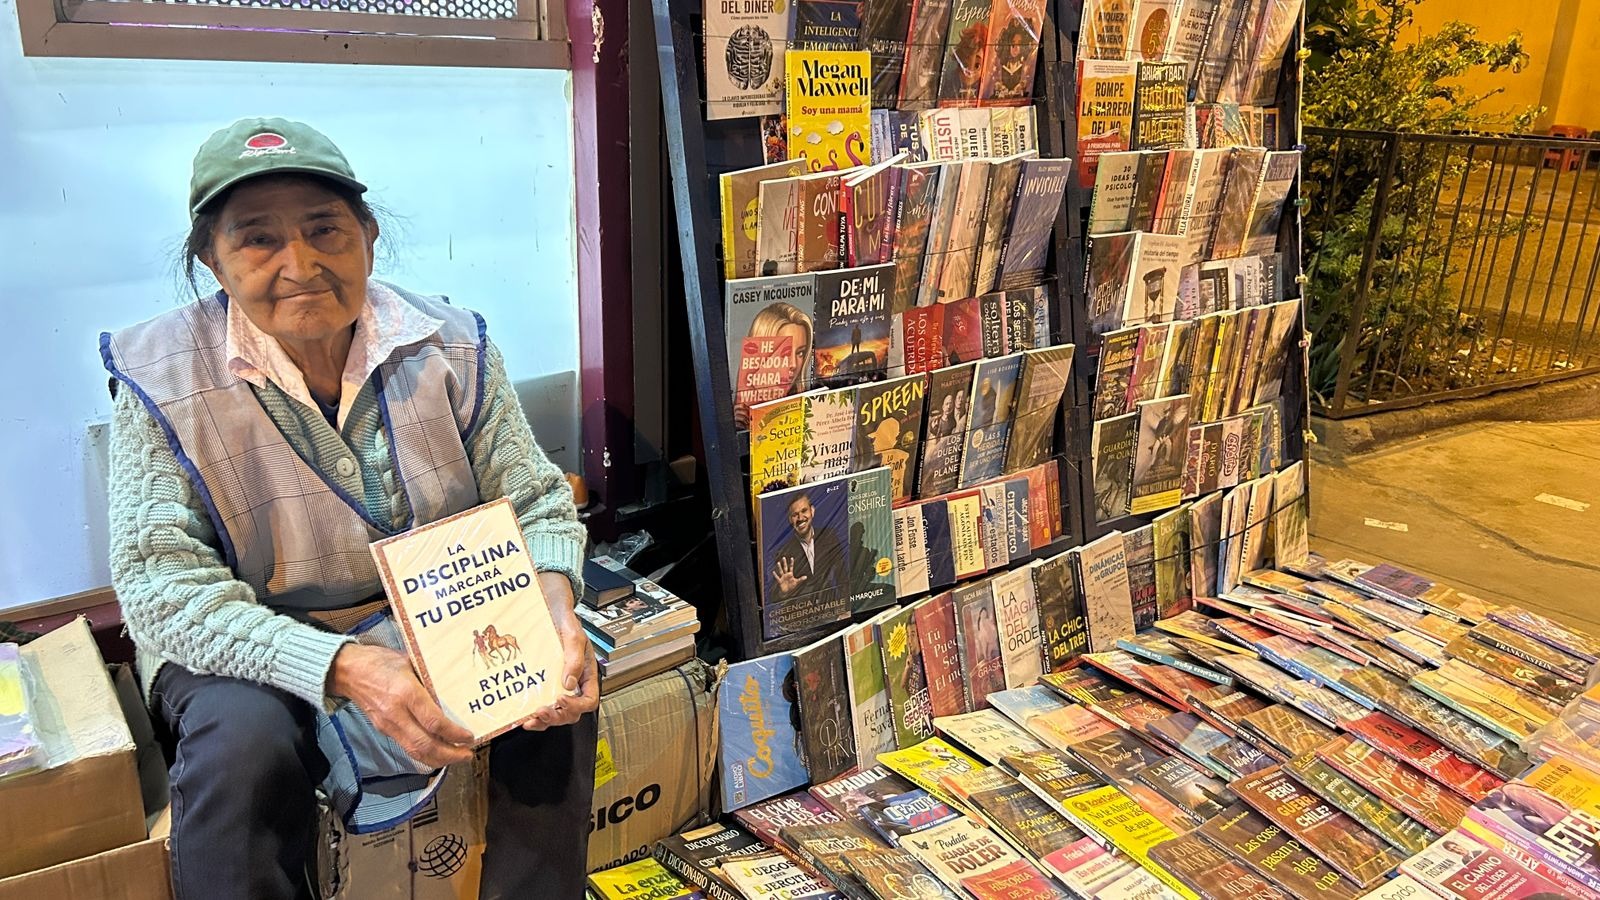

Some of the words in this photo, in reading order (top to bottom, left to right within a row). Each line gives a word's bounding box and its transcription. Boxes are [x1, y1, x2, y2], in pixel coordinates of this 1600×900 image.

[722, 1, 740, 14] DEL
[831, 12, 841, 21] LA
[802, 60, 860, 81] Megan
[1141, 64, 1162, 81] BRIAN
[797, 78, 868, 97] Maxwell
[1095, 82, 1124, 97] ROMPE
[802, 106, 817, 116] Soy
[838, 104, 863, 114] mamá
[1082, 102, 1093, 116] LA
[1095, 101, 1132, 117] BARRERA
[899, 123, 908, 138] DE
[910, 123, 919, 150] TUS
[1091, 121, 1105, 135] DEL
[968, 127, 978, 158] QUIER
[1024, 175, 1066, 198] INVISIBLE
[1111, 174, 1130, 182] IDEAS
[733, 290, 761, 304] CASEY
[763, 285, 812, 300] MCQUISTON
[1012, 300, 1021, 319] LOS
[918, 313, 927, 336] LOS
[989, 302, 1001, 355] soltera
[761, 340, 774, 353] HE
[742, 357, 778, 369] BESADO
[780, 356, 789, 367] A
[746, 373, 781, 387] SHARA
[740, 389, 785, 402] WHEELER
[861, 381, 924, 427] SPREEN
[770, 425, 800, 441] Secre
[946, 435, 961, 445] LOS
[985, 432, 996, 442] LAS
[944, 455, 959, 465] DEL
[934, 465, 958, 479] PLANE
[1006, 491, 1017, 554] CIENTÍFICO
[908, 526, 917, 548] Fosse
[989, 528, 998, 564] estados
[447, 542, 465, 557] LA
[403, 540, 520, 595] DISCIPLINA
[1101, 561, 1126, 580] GRUPOS
[435, 564, 502, 600] MARCARÁ
[415, 606, 443, 628] TU
[447, 572, 531, 617] DESTINO
[856, 588, 883, 600] MARQUEZ
[1001, 591, 1017, 608] LA
[1006, 620, 1027, 638] DEL
[1008, 624, 1041, 652] ORDE
[1048, 628, 1061, 645] LA
[1061, 615, 1086, 638] CHIC
[1052, 641, 1069, 661] DEL
[1495, 642, 1552, 671] FRANKENSTEIN
[479, 662, 527, 692] RYAN
[468, 669, 547, 713] HOLIDAY
[746, 672, 776, 780] Coquito
[971, 724, 1005, 742] GRAN
[1152, 766, 1164, 777] LA
[1164, 770, 1177, 784] ME
[817, 766, 893, 799] LAPADULA
[1024, 808, 1039, 818] EL
[1102, 816, 1118, 828] en
[1115, 812, 1130, 824] un
[1295, 805, 1332, 828] CHILE?
[1124, 823, 1137, 833] de
[1135, 818, 1155, 830] agua
[684, 829, 740, 852] DICCIONARIO
[715, 844, 730, 854] DE
[936, 841, 978, 863] DEJARÁS
[979, 836, 994, 849] DE
[1235, 842, 1261, 856] Las
[1255, 824, 1281, 844] cosa
[858, 853, 881, 868] Eric
[944, 843, 1008, 876] DOLER
[1260, 847, 1296, 872] pasan
[1293, 856, 1322, 877] algo,
[1502, 843, 1542, 872] AFTER
[667, 855, 709, 890] DICCIONARIO
[743, 859, 798, 878] JUEGOS
[1218, 868, 1235, 879] LA
[1452, 878, 1469, 892] EL
[1462, 855, 1502, 884] CAMINO
[613, 882, 637, 896] La
[988, 871, 1034, 893] HISTORIA
[1221, 873, 1261, 897] MEJOR
[1314, 881, 1325, 891] o
[1322, 871, 1344, 890] no.
[1474, 880, 1490, 894] DEL
[1485, 868, 1510, 886] LÍDER
